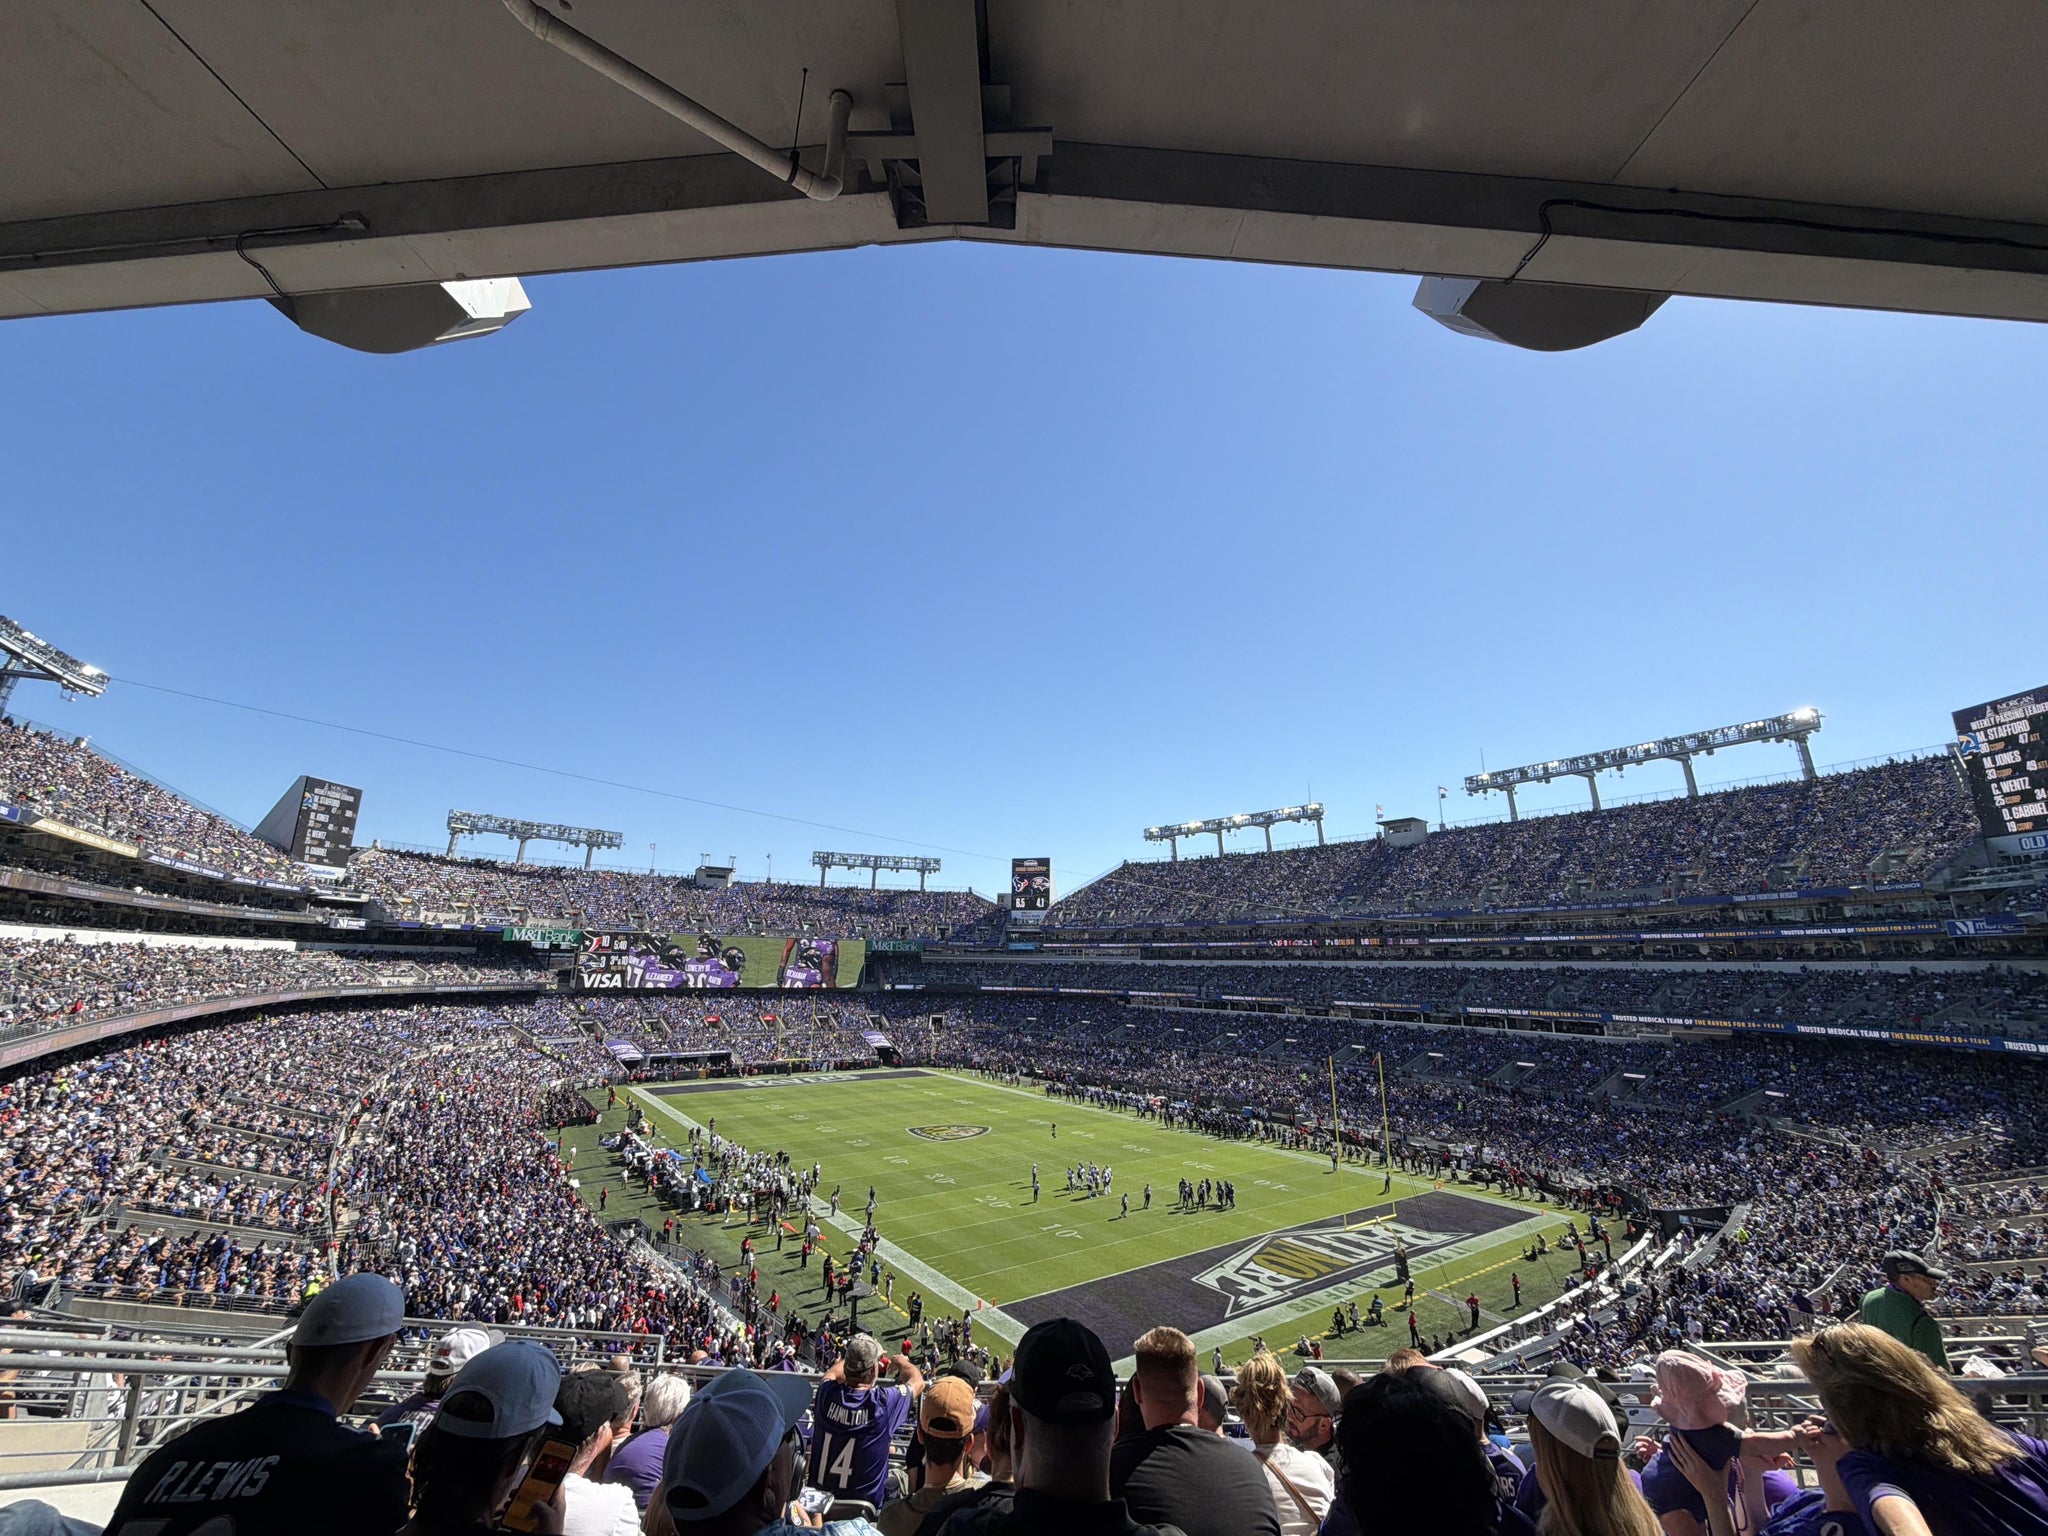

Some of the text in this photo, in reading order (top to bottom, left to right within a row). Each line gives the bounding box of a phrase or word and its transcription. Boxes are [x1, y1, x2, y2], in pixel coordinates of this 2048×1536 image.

[1970, 716, 1995, 730] WEEKLY
[1996, 708, 2025, 724] PASSING
[1987, 720, 2030, 740] STAFFORD
[1980, 743, 1990, 753] 30
[2018, 733, 2028, 744] 47
[1983, 750, 2022, 769] M. JONES
[1986, 769, 1997, 780] 33
[2027, 760, 2038, 771] 49
[1991, 777, 2031, 795] C. WENTZ
[1994, 795, 2006, 806] 25
[2034, 788, 2047, 800] 34
[2002, 802, 2048, 820] D. GABRIEL
[2006, 821, 2017, 832] 19
[2021, 836, 2046, 850] OLD
[512, 928, 575, 942] M&T Bank
[602, 935, 610, 947] 10
[613, 940, 628, 950] 5:40
[872, 941, 918, 951] M&T Bank
[600, 956, 606, 968] 3
[685, 964, 704, 972] LOWERY
[580, 974, 622, 988] VISA
[1638, 1016, 1666, 1024] MEDICAL
[1666, 1017, 1683, 1025] TEAM
[1796, 1025, 1826, 1034] TRUSTED
[1827, 1027, 1859, 1037] MEDICAL
[1860, 1029, 1880, 1038] TEAM
[1881, 1031, 1890, 1039] OF
[1891, 1032, 1904, 1040] THE
[1906, 1033, 1934, 1042] RAVENS
[1935, 1034, 1951, 1043] FOR
[1969, 1037, 1990, 1045] YEARS
[2003, 1041, 2037, 1052] TRUSTED
[1196, 1222, 1467, 1308] BALTIMORE
[1325, 1286, 1351, 1301] OF
[827, 1402, 868, 1426] HAMILTON
[817, 1432, 856, 1489] 14
